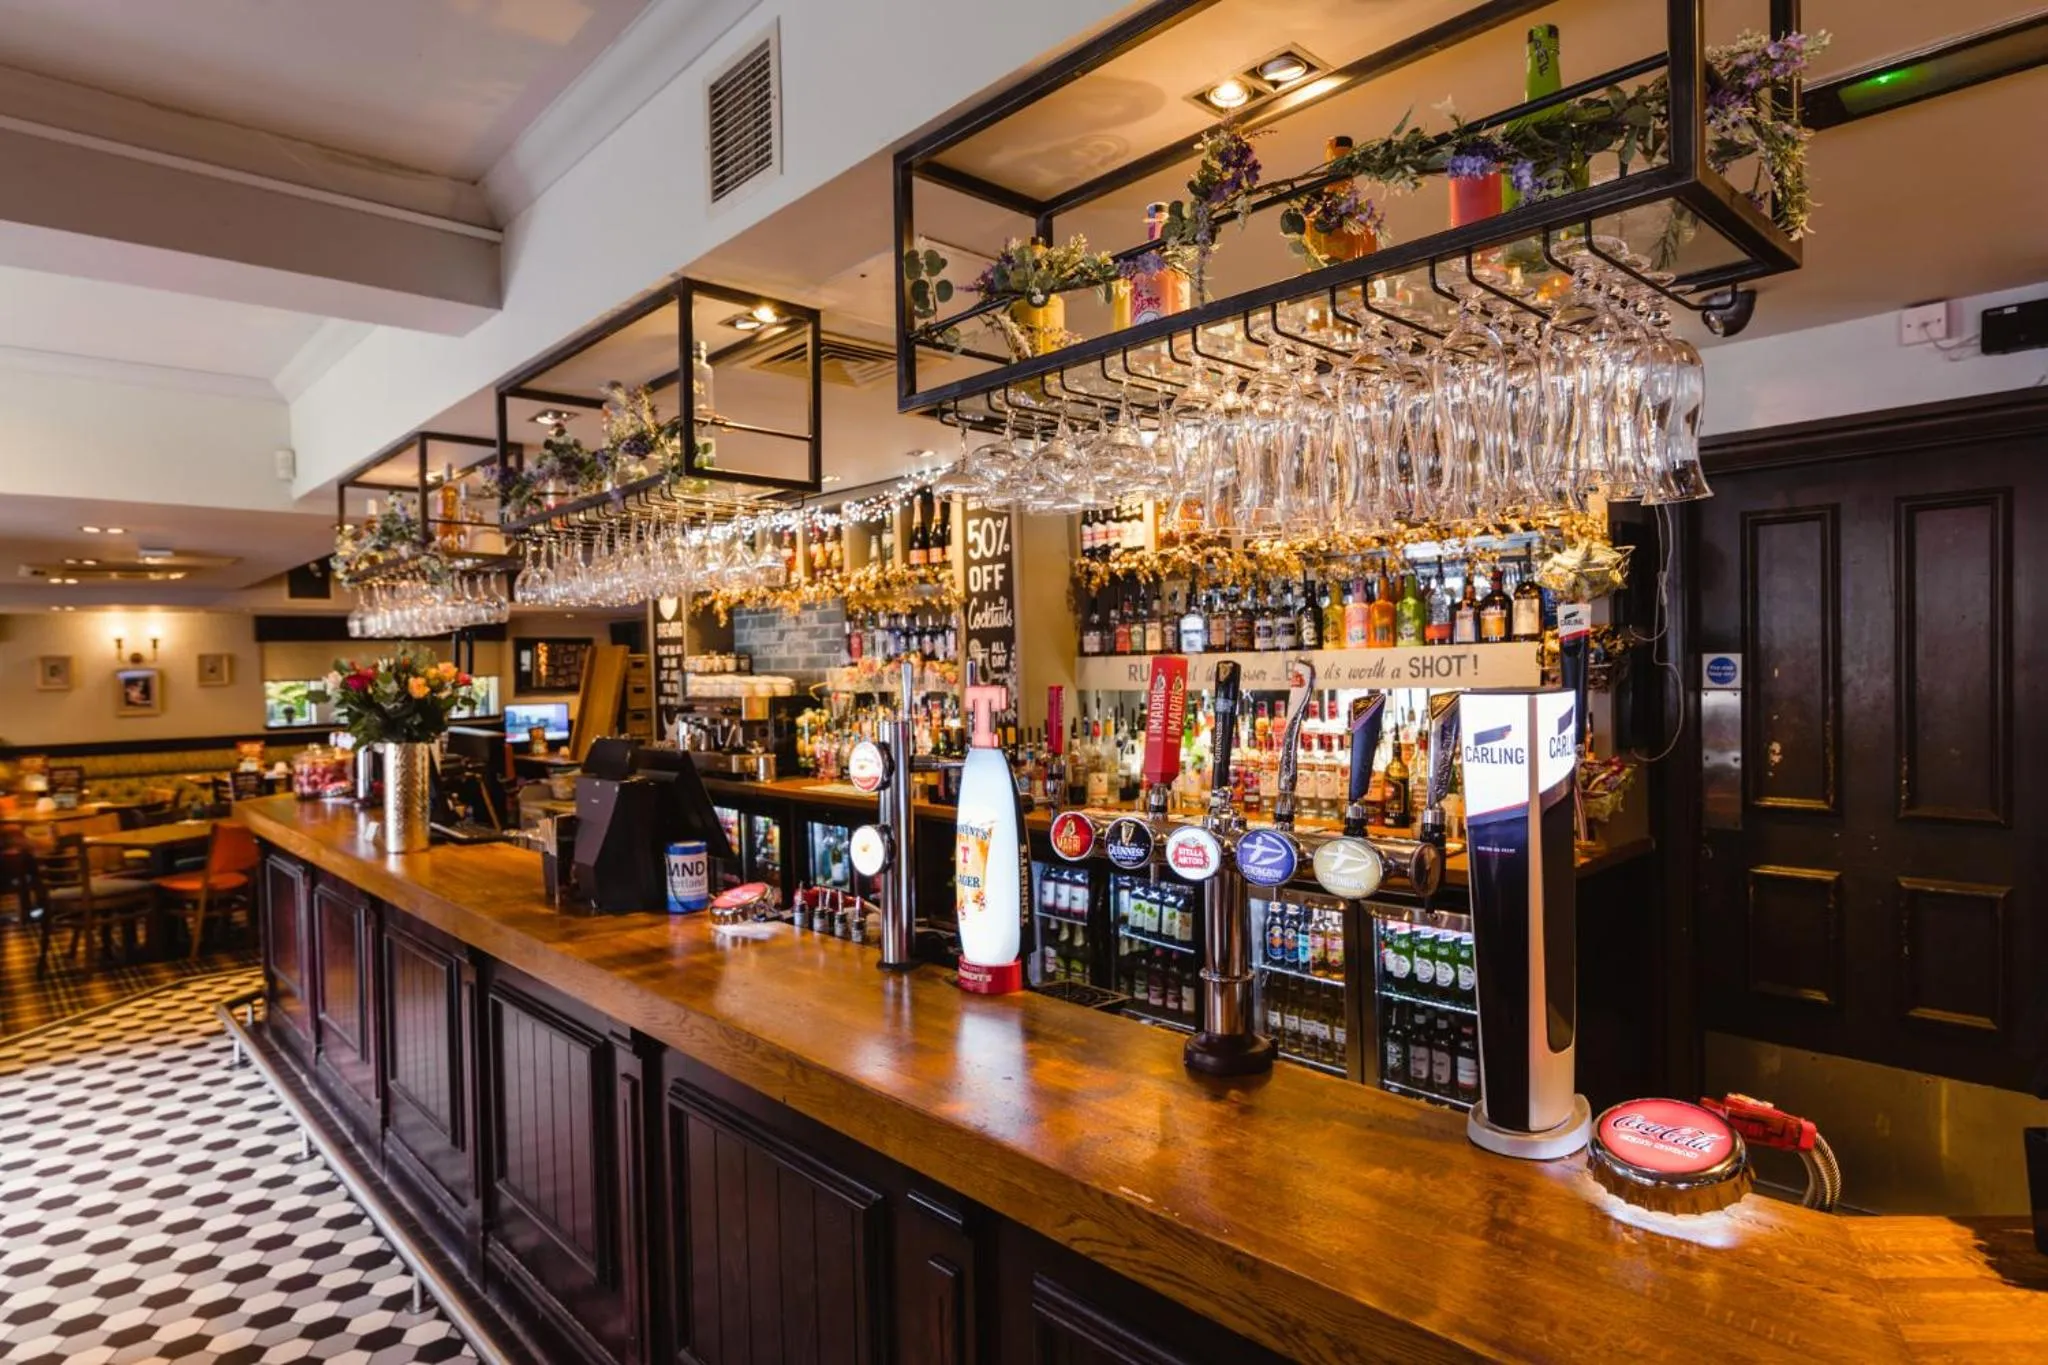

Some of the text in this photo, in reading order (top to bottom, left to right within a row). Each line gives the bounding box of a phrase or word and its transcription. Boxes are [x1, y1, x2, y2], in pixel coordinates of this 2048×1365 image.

[967, 516, 1010, 560] 50%
[969, 563, 1006, 593] OFF
[968, 596, 1013, 630] Cocktails
[991, 641, 1006, 653] ALL
[1128, 664, 1150, 682] RU
[1347, 657, 1385, 679] worth
[1391, 667, 1401, 678] a
[965, 685, 1008, 748] T
[1465, 746, 1525, 764] CARLING
[1108, 843, 1145, 857] GUINNESS
[1178, 847, 1204, 857] STELLA
[1178, 856, 1205, 865] ARTOIS
[1612, 1114, 1725, 1152] Coca-Cola
